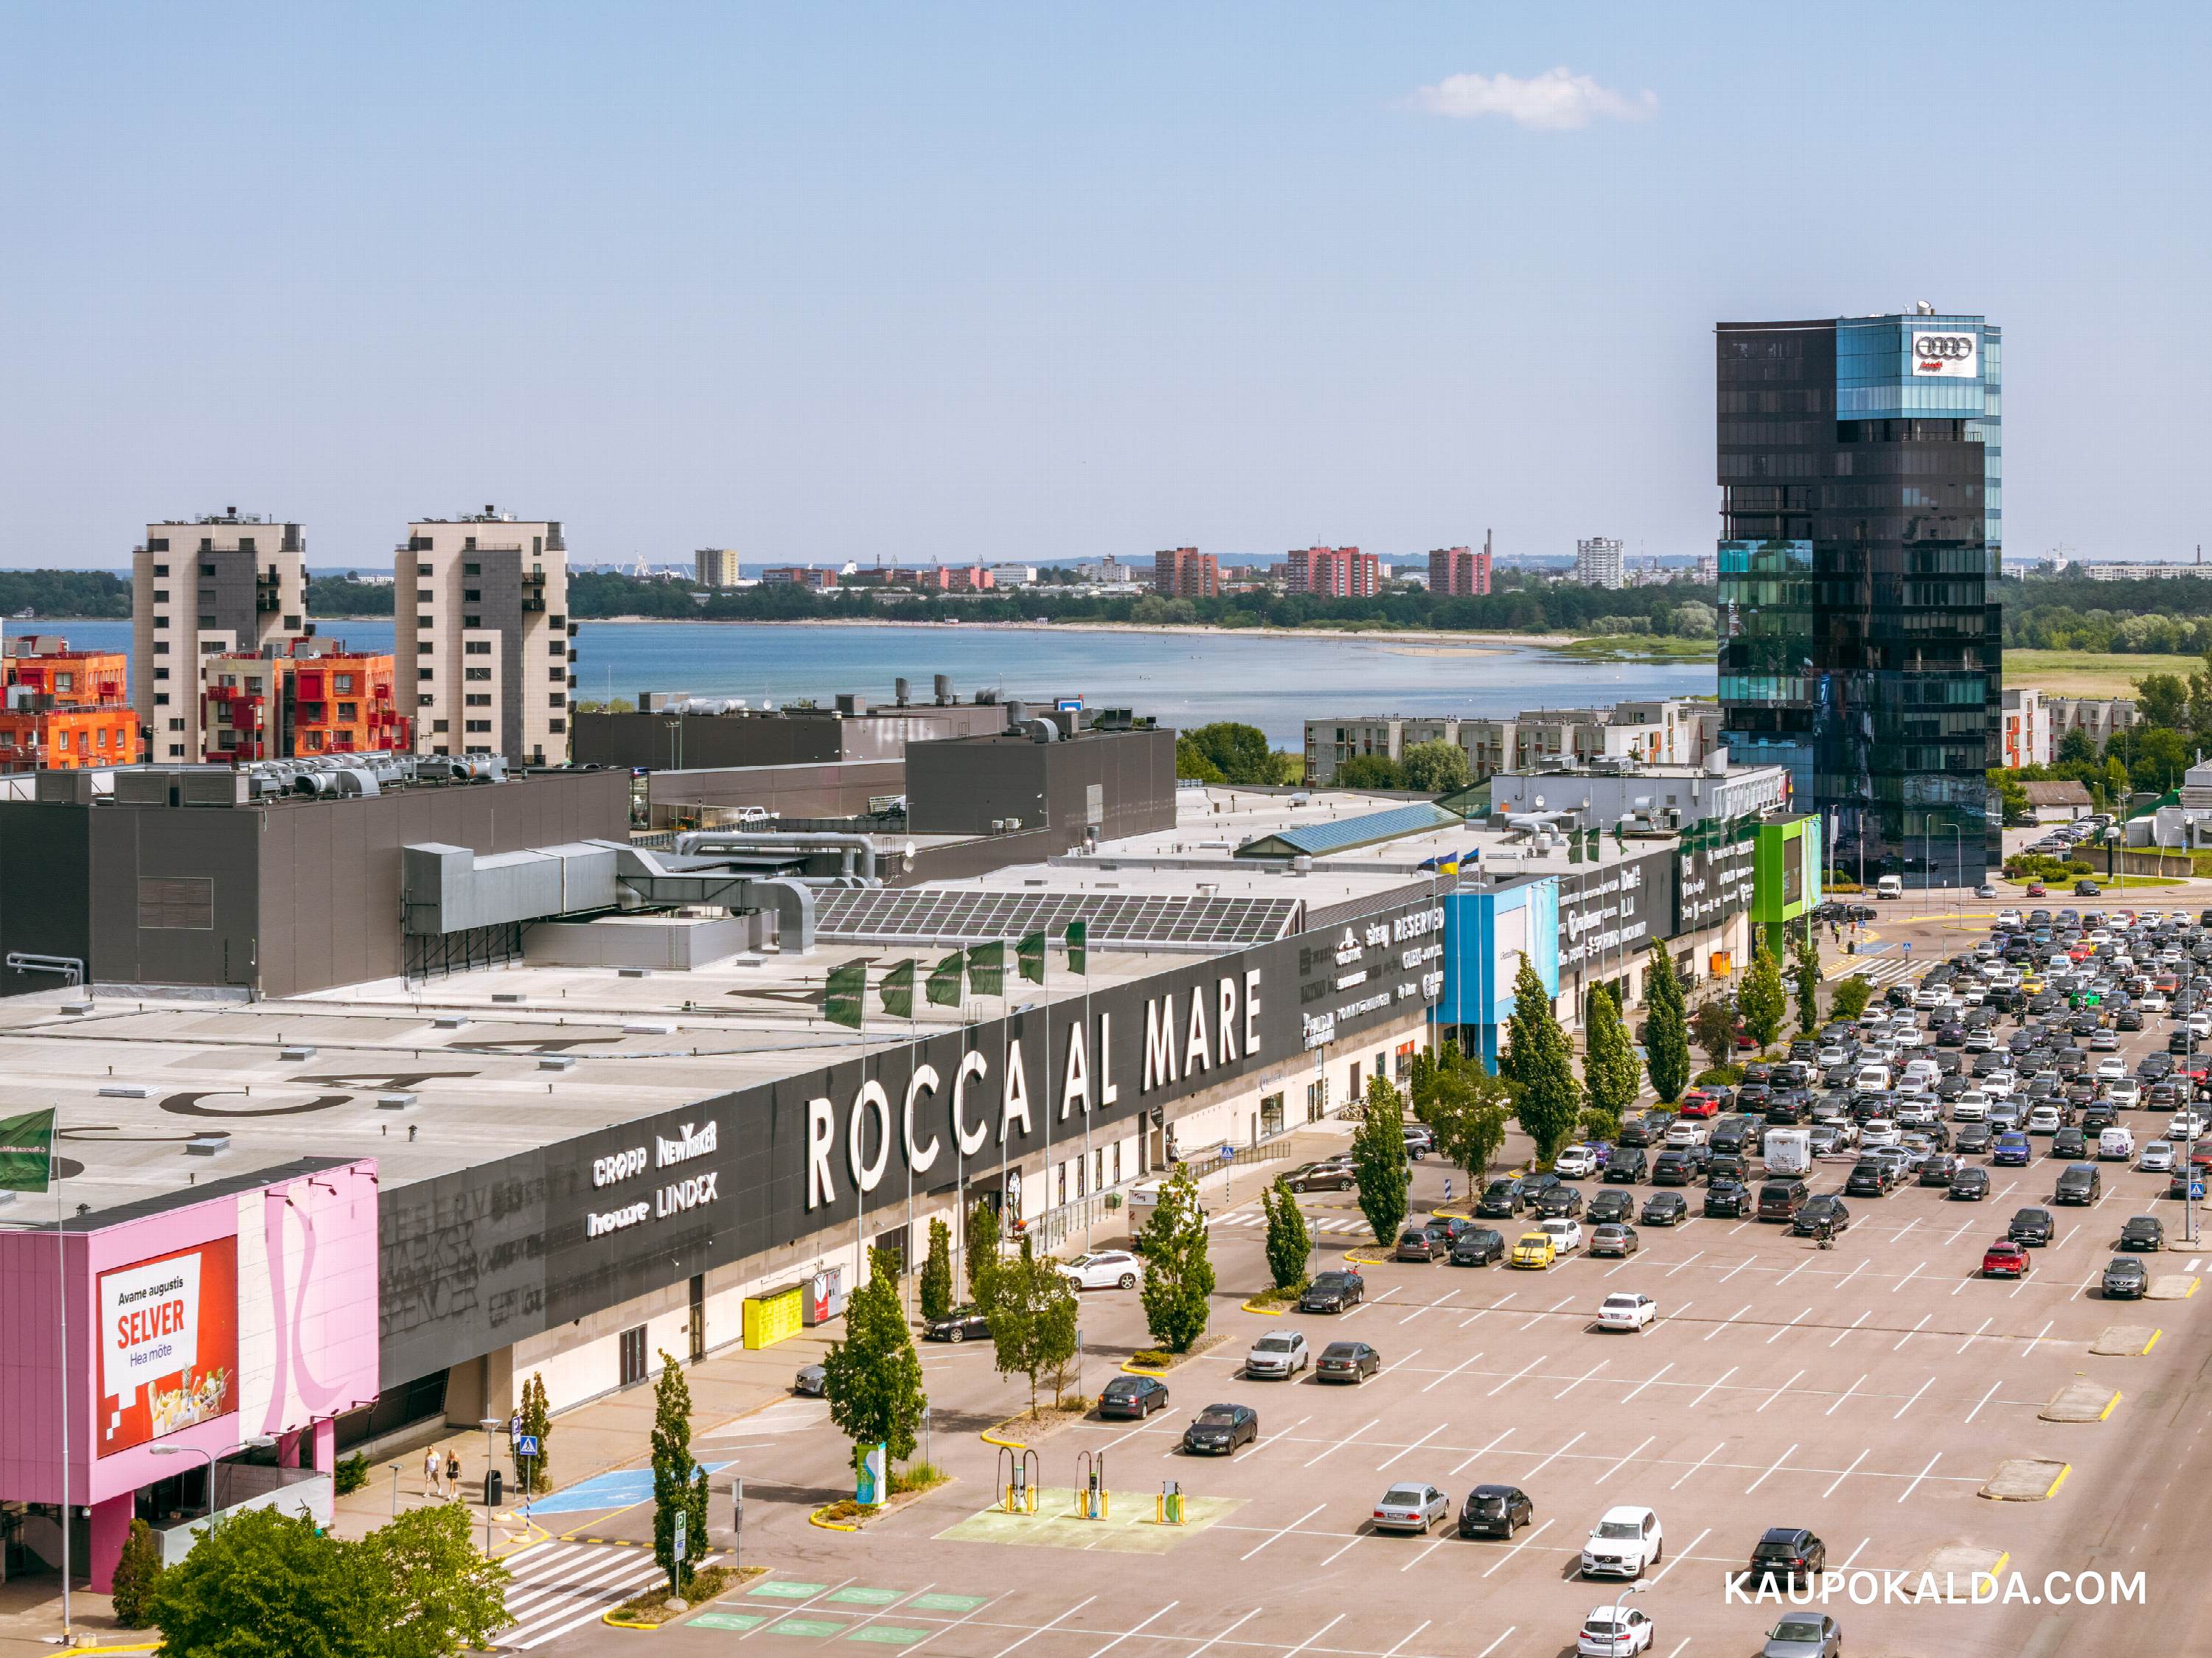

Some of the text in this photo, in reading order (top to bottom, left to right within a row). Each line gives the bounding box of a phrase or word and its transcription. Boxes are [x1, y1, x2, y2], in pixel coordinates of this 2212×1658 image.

[1394, 907, 1444, 942] RESERVED
[807, 968, 1261, 1208] ROCCA AL MARE
[593, 1147, 647, 1186] CROPP
[655, 1172, 718, 1218] LINDEX
[587, 1202, 650, 1237] house
[118, 1275, 184, 1306] Avame augustis
[117, 1299, 184, 1349] SELVER
[130, 1344, 173, 1367] Hea mõte
[858, 1463, 872, 1500] eleport
